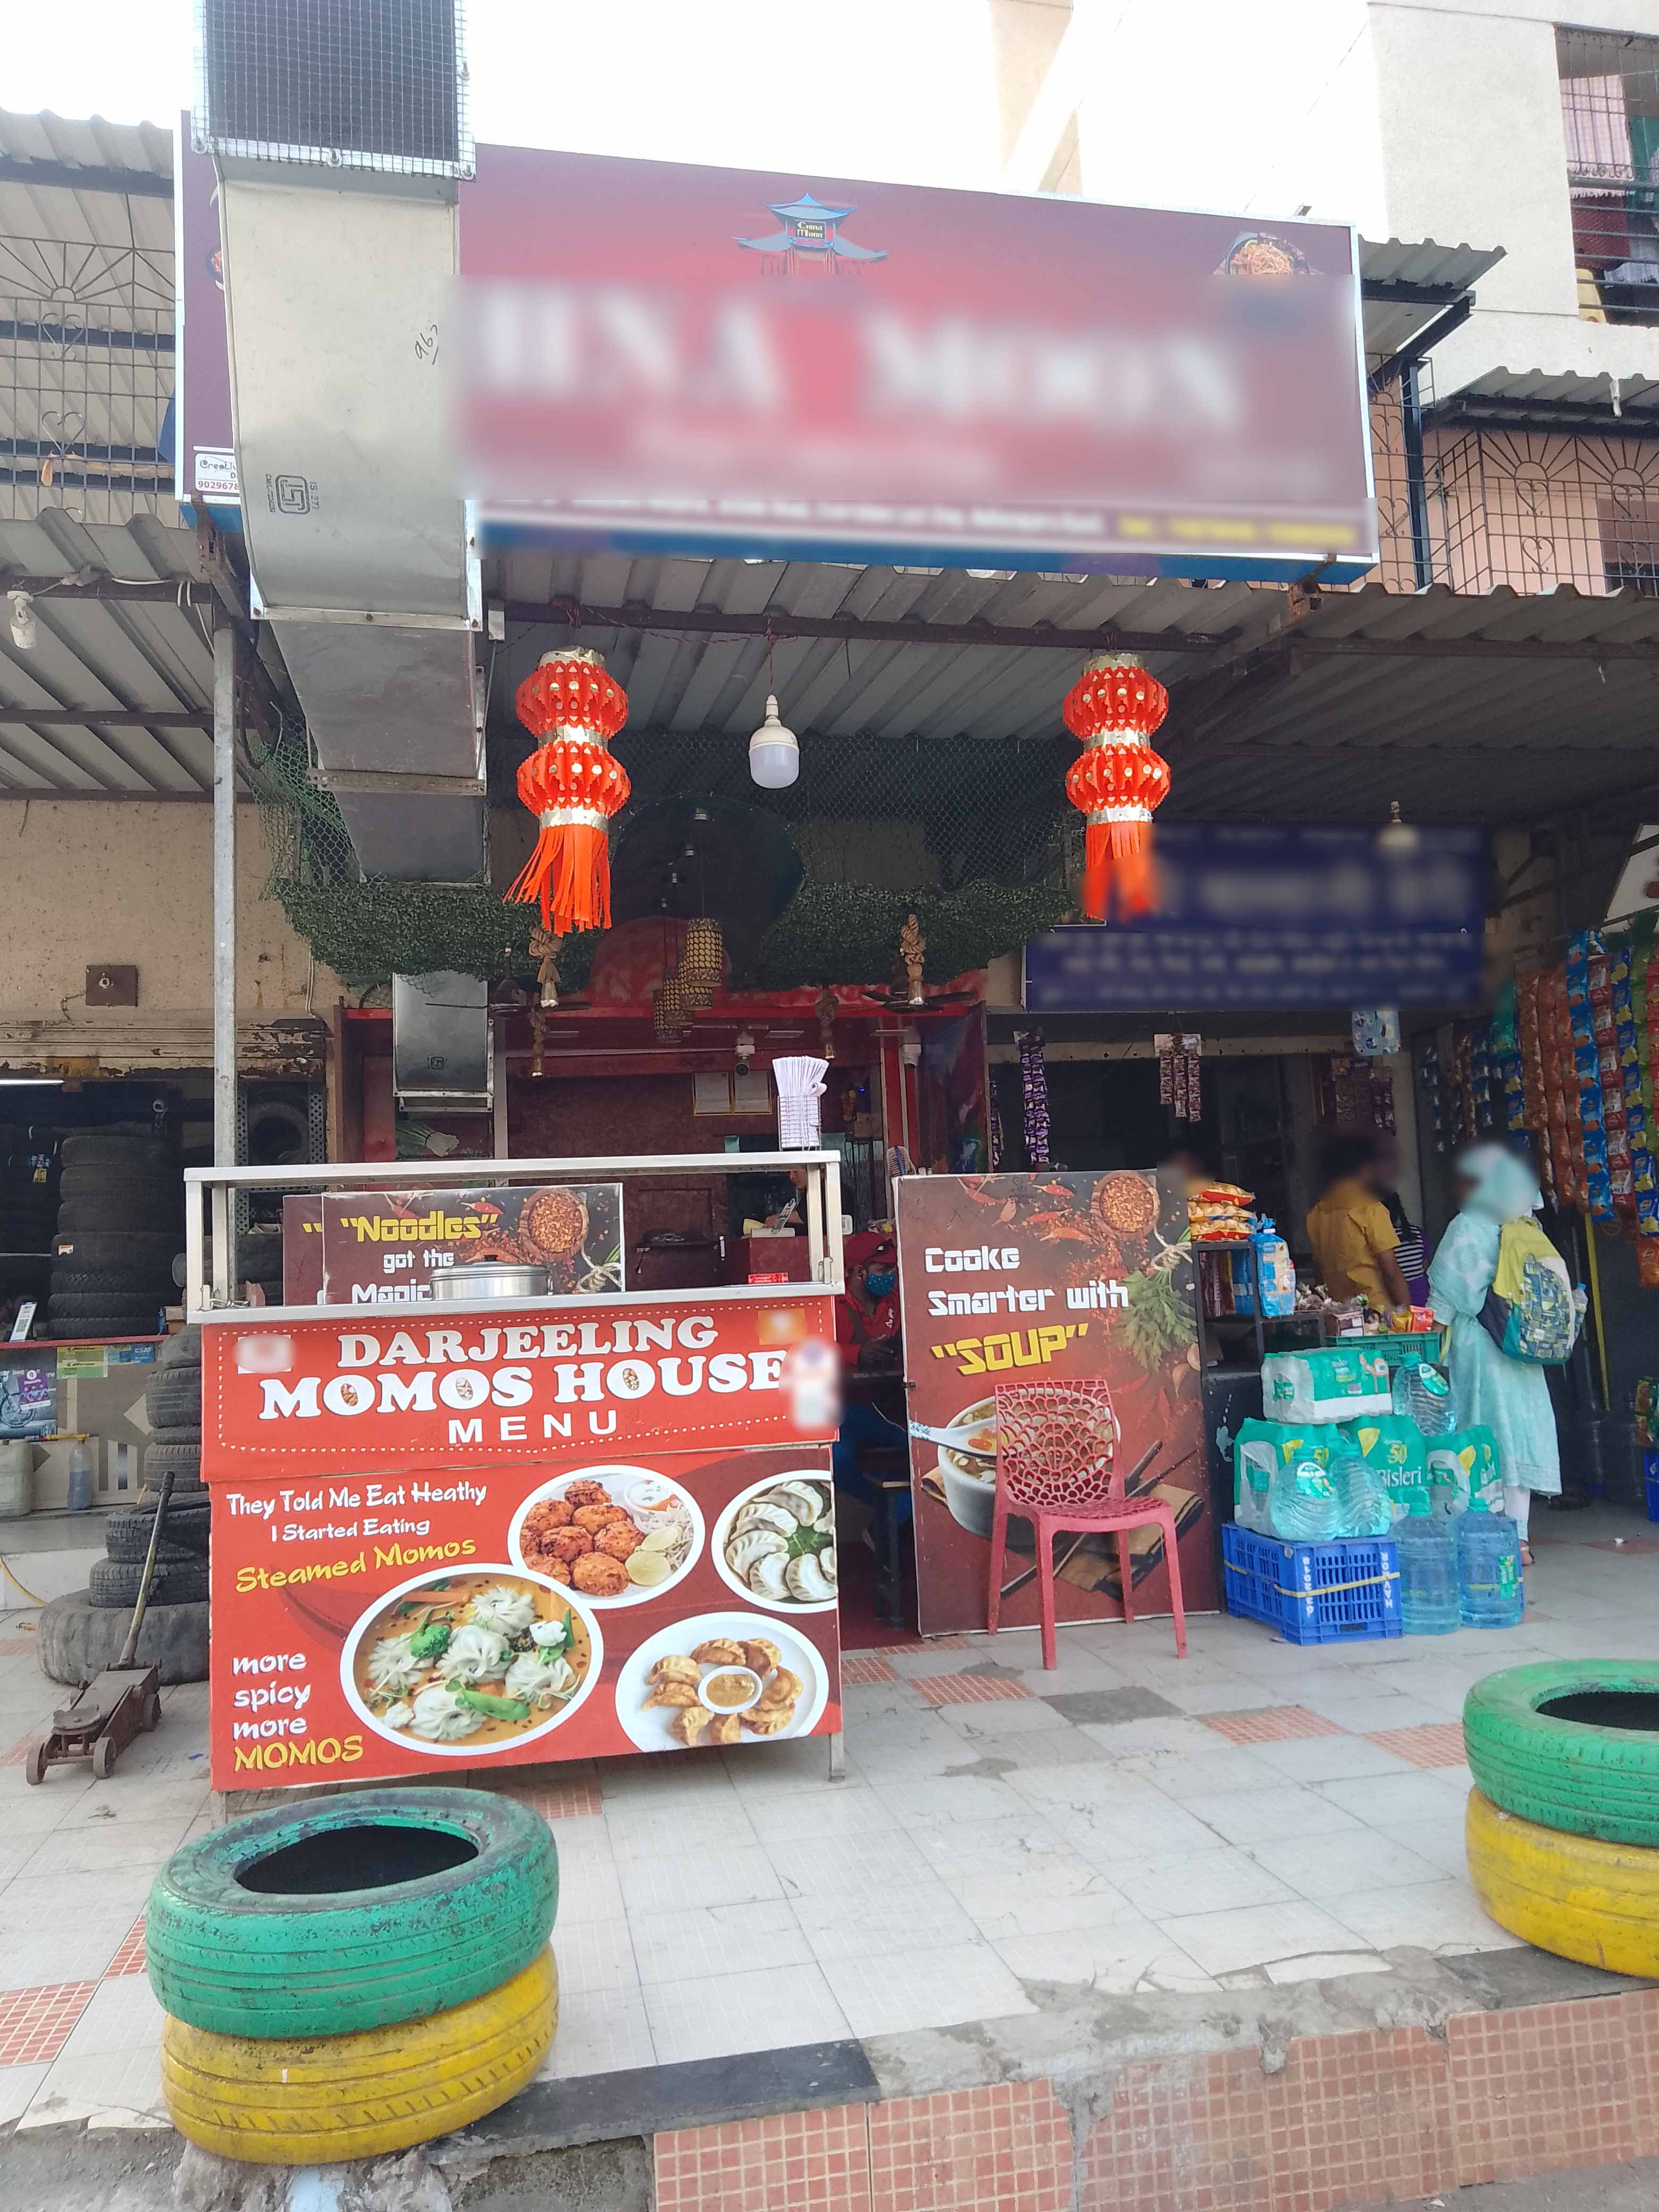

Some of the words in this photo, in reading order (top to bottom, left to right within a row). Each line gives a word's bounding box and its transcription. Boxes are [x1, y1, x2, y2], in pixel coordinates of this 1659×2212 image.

[383, 1250, 416, 1274] got
[423, 1248, 455, 1268] the
[924, 1245, 1020, 1273] Cooke
[927, 1284, 1055, 1317] Smarter
[1066, 1279, 1129, 1310] with
[337, 1316, 719, 1368] DARJEELING
[258, 1366, 533, 1420] MOMOS
[554, 1350, 789, 1403] HOUSE
[448, 1409, 617, 1444] MENU
[226, 1493, 275, 1519] They
[280, 1489, 323, 1512] Told
[329, 1487, 362, 1510] Me
[366, 1483, 406, 1505] Eat
[411, 1481, 487, 1505] Heathy
[271, 1526, 278, 1542] I
[282, 1521, 358, 1541] Started
[363, 1518, 431, 1536] Eating
[236, 1552, 366, 1594] Steamed
[374, 1539, 477, 1570] Momos
[232, 1653, 307, 1676] more
[233, 1681, 311, 1713] spicy
[232, 1716, 308, 1741] more
[234, 1735, 364, 1773] MOMOS
